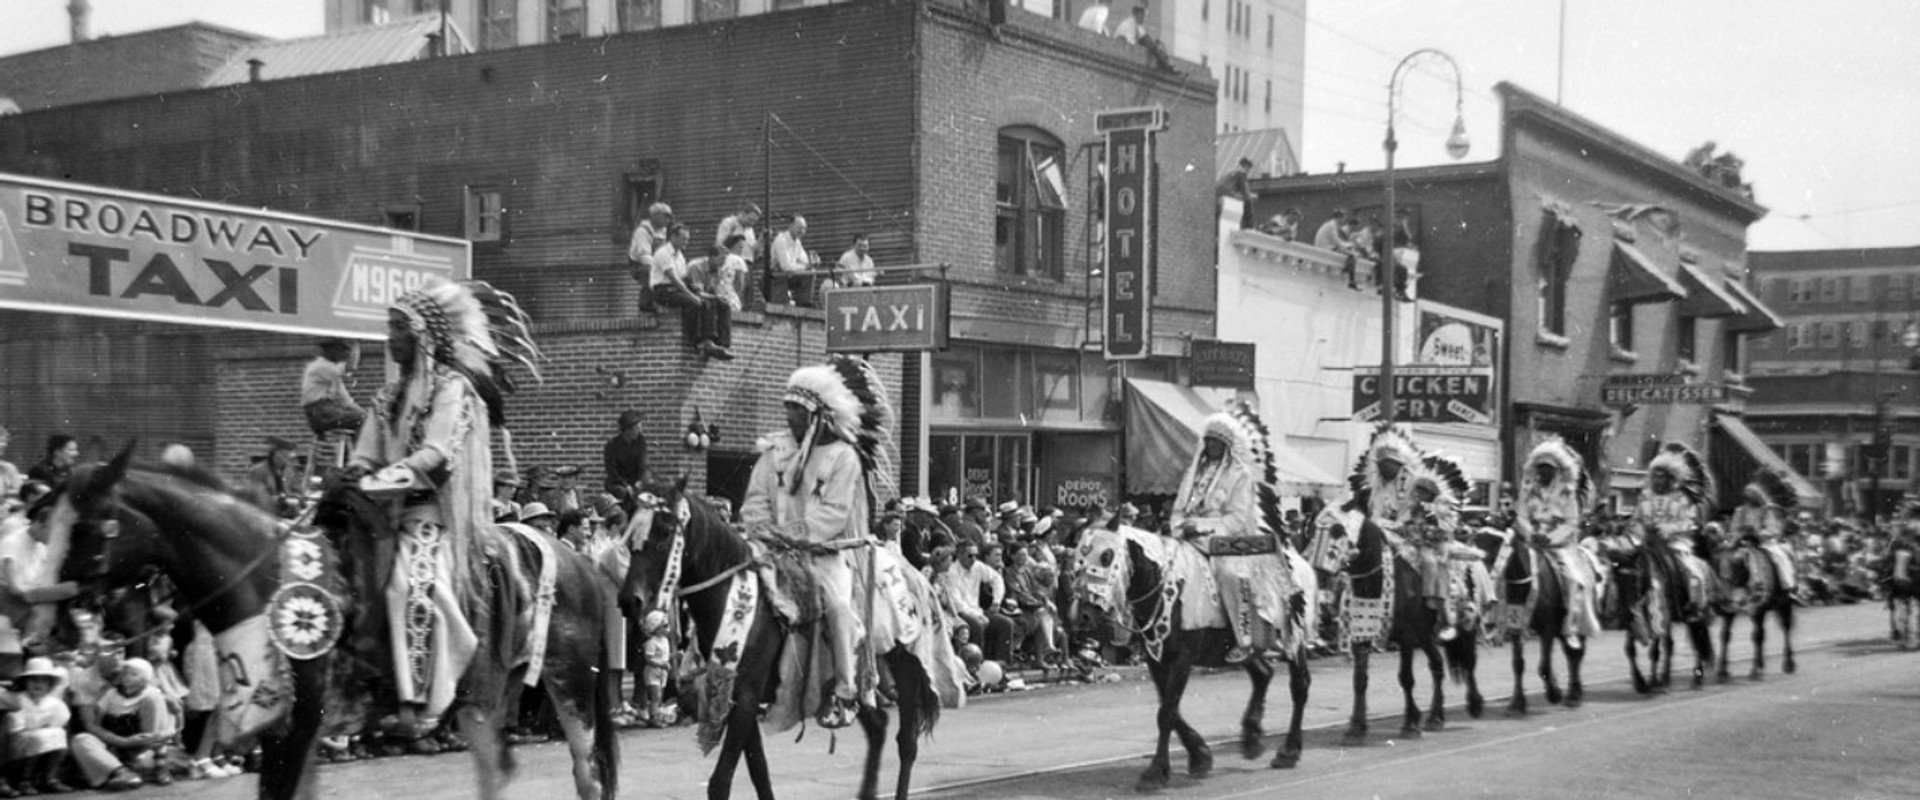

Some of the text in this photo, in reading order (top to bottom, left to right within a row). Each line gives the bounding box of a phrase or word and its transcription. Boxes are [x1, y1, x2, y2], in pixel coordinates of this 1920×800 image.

[25, 193, 323, 258] BROADWAY
[1115, 143, 1137, 342] HOTEL
[67, 241, 299, 315] TAXI
[352, 263, 434, 305] M96
[838, 303, 924, 333] TAXI
[1360, 376, 1480, 395] CICKEN
[1393, 399, 1441, 418] FRY
[1057, 484, 1108, 508] ROOMS
[1064, 479, 1102, 491] DEPOT
